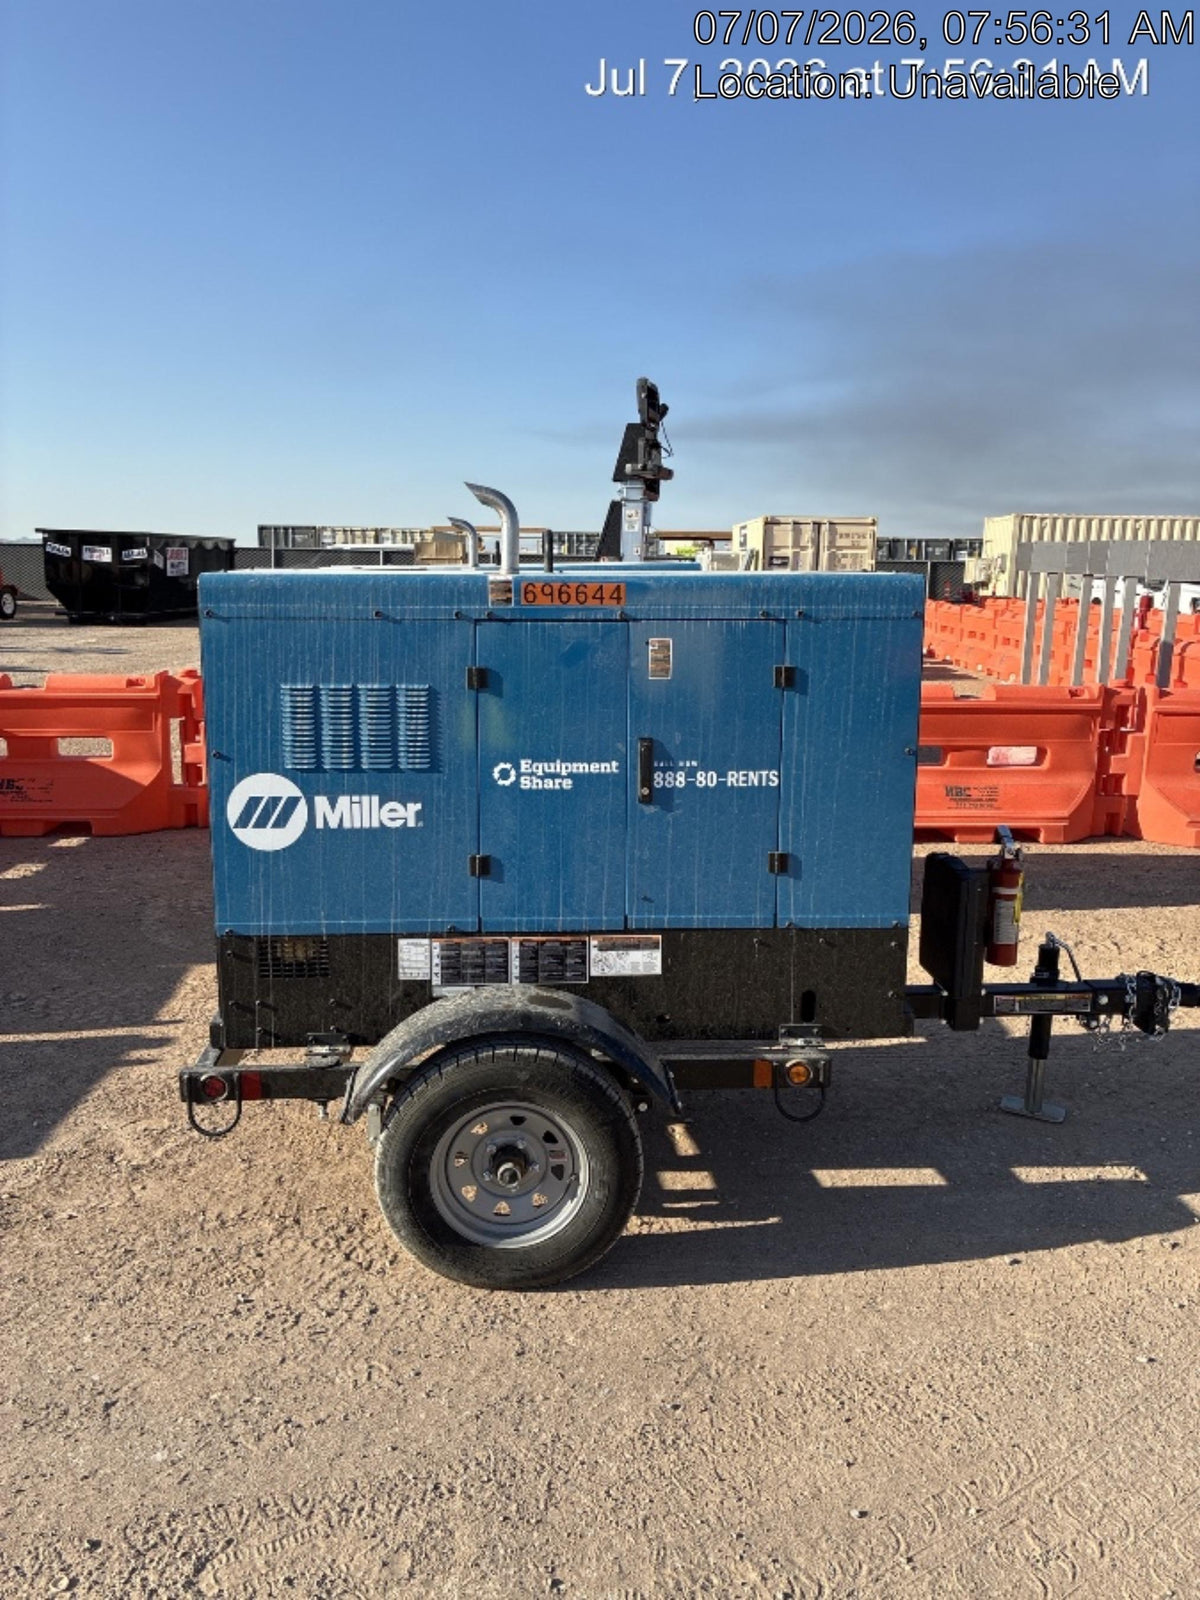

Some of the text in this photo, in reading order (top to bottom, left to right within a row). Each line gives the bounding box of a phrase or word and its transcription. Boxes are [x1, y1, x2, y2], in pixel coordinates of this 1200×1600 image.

[523, 582, 624, 606] 696644
[520, 759, 620, 776] Equipment
[520, 776, 574, 790] Share
[653, 770, 780, 788] 888-80-RENTS
[314, 795, 422, 830] Miller
